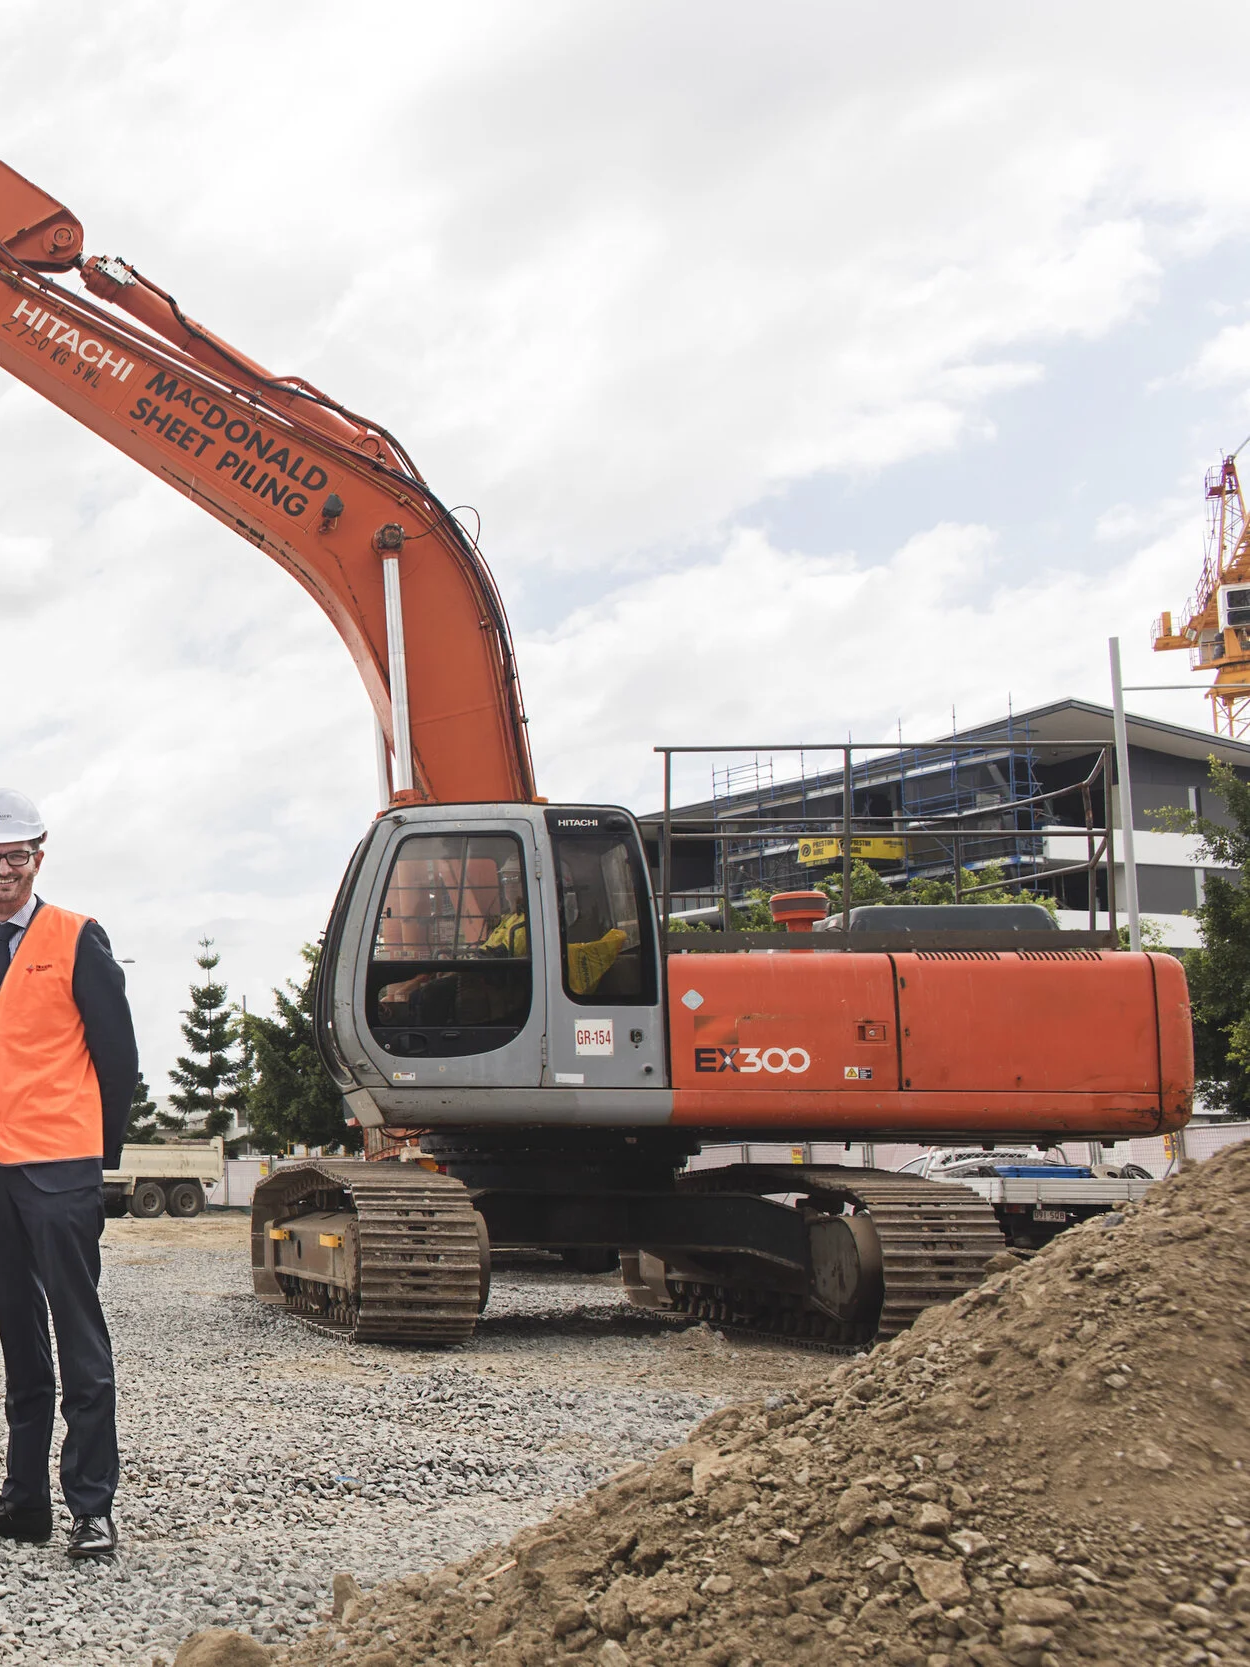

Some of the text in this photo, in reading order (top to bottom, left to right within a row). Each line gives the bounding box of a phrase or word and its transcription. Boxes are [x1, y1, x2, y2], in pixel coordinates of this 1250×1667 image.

[1, 315, 102, 389] 2750 KG SWL
[12, 298, 135, 383] HITACHI
[129, 397, 309, 517] SHEET PILING
[145, 371, 328, 492] MACDONALD
[557, 819, 599, 827] HITACHI
[576, 1030, 611, 1045] GR-154
[695, 1047, 811, 1074] EX300
